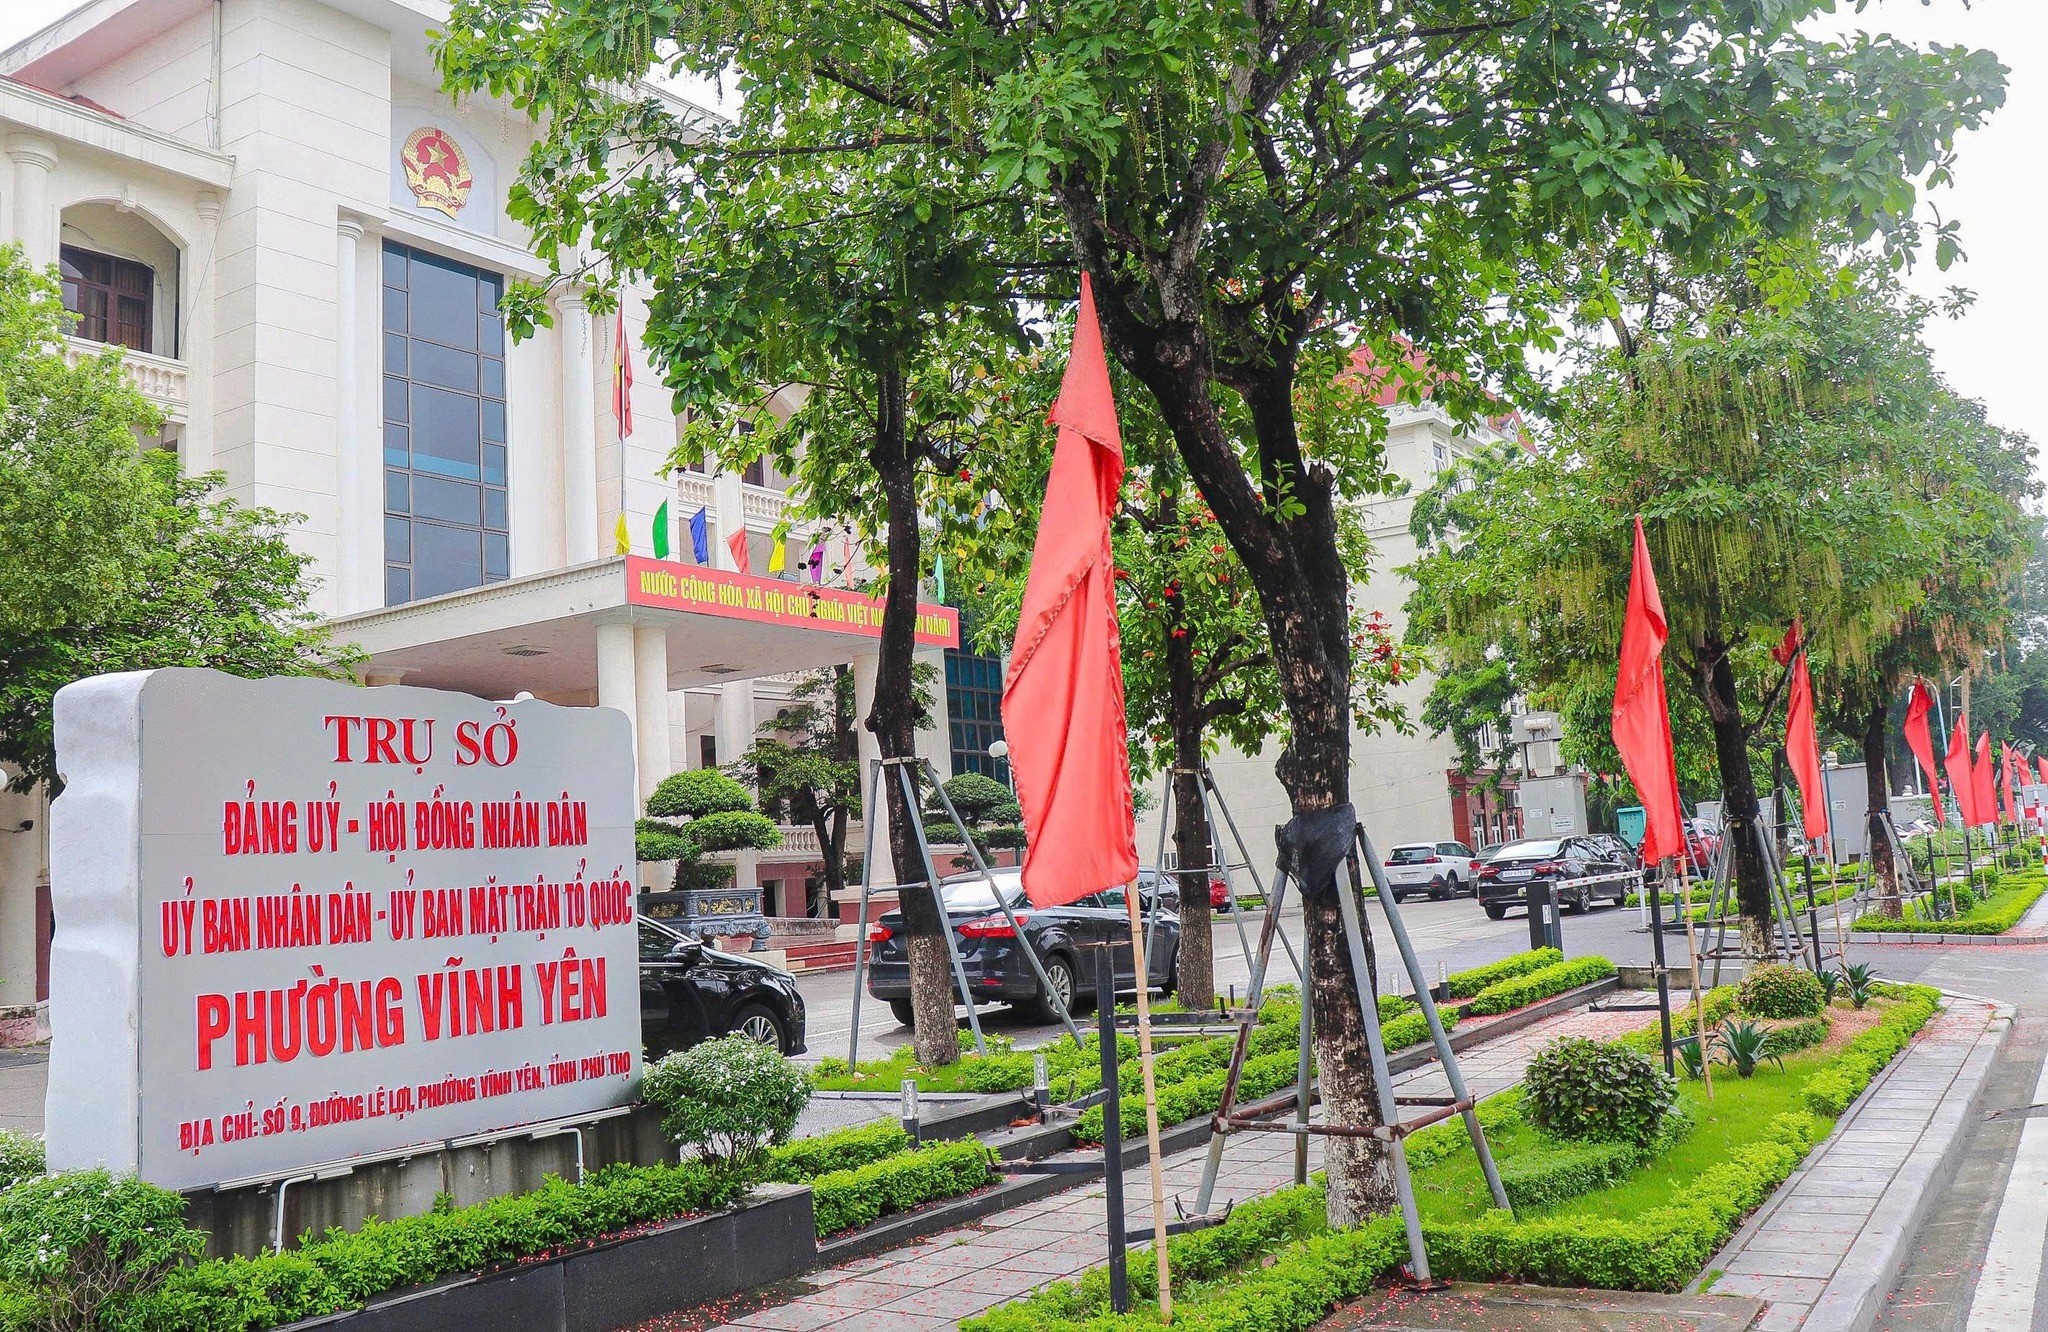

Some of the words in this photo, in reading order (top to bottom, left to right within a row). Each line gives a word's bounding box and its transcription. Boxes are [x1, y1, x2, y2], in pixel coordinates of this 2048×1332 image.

[640, 570, 678, 598] NƯỚC
[680, 574, 715, 605] CỘNG
[718, 580, 744, 608] HÒA
[746, 585, 763, 610] XÃ
[765, 588, 785, 617] HỘI
[788, 591, 810, 618] CHỦ
[812, 598, 846, 622] NGHĨA
[847, 601, 869, 629] VIỆT
[926, 613, 951, 638] NĂM!
[323, 715, 435, 775] TRỤ
[454, 706, 518, 766] SỞ
[222, 779, 298, 856] ĐẢNG
[305, 781, 341, 853] UỶ
[346, 819, 360, 833] -
[367, 789, 408, 864] HỘI
[414, 783, 475, 850] ĐỒNG
[481, 790, 541, 849] NHÂN
[546, 791, 589, 847] DÂN
[161, 876, 196, 959] UỶ
[201, 897, 251, 955] BAN
[256, 883, 323, 950] NHÂN
[327, 881, 373, 946] DÂN
[389, 868, 418, 942] UỶ
[421, 888, 464, 940] BAN
[468, 873, 509, 944] MẶT
[510, 874, 561, 941] TRẬN
[563, 857, 587, 929] TỔ
[588, 864, 634, 932] QUỐC
[195, 964, 406, 1072] PHƯỜNG
[416, 955, 525, 1042] VĨNH
[534, 946, 608, 1025] YÊN
[178, 1118, 216, 1156] ĐỊA
[220, 1099, 260, 1144] CHỈ:
[261, 1097, 289, 1137] SỐ
[308, 1089, 365, 1129] ĐƯỜNG
[367, 1084, 387, 1119] LÊ
[388, 1084, 416, 1122] LỢI,
[418, 1072, 477, 1111] PHƯỜNG
[479, 1068, 513, 1099] VĨNH
[514, 1062, 546, 1091] YÊN,
[548, 1053, 578, 1087] TỈNH
[580, 1049, 605, 1081] PHÚ
[606, 1050, 632, 1081] THỌ
